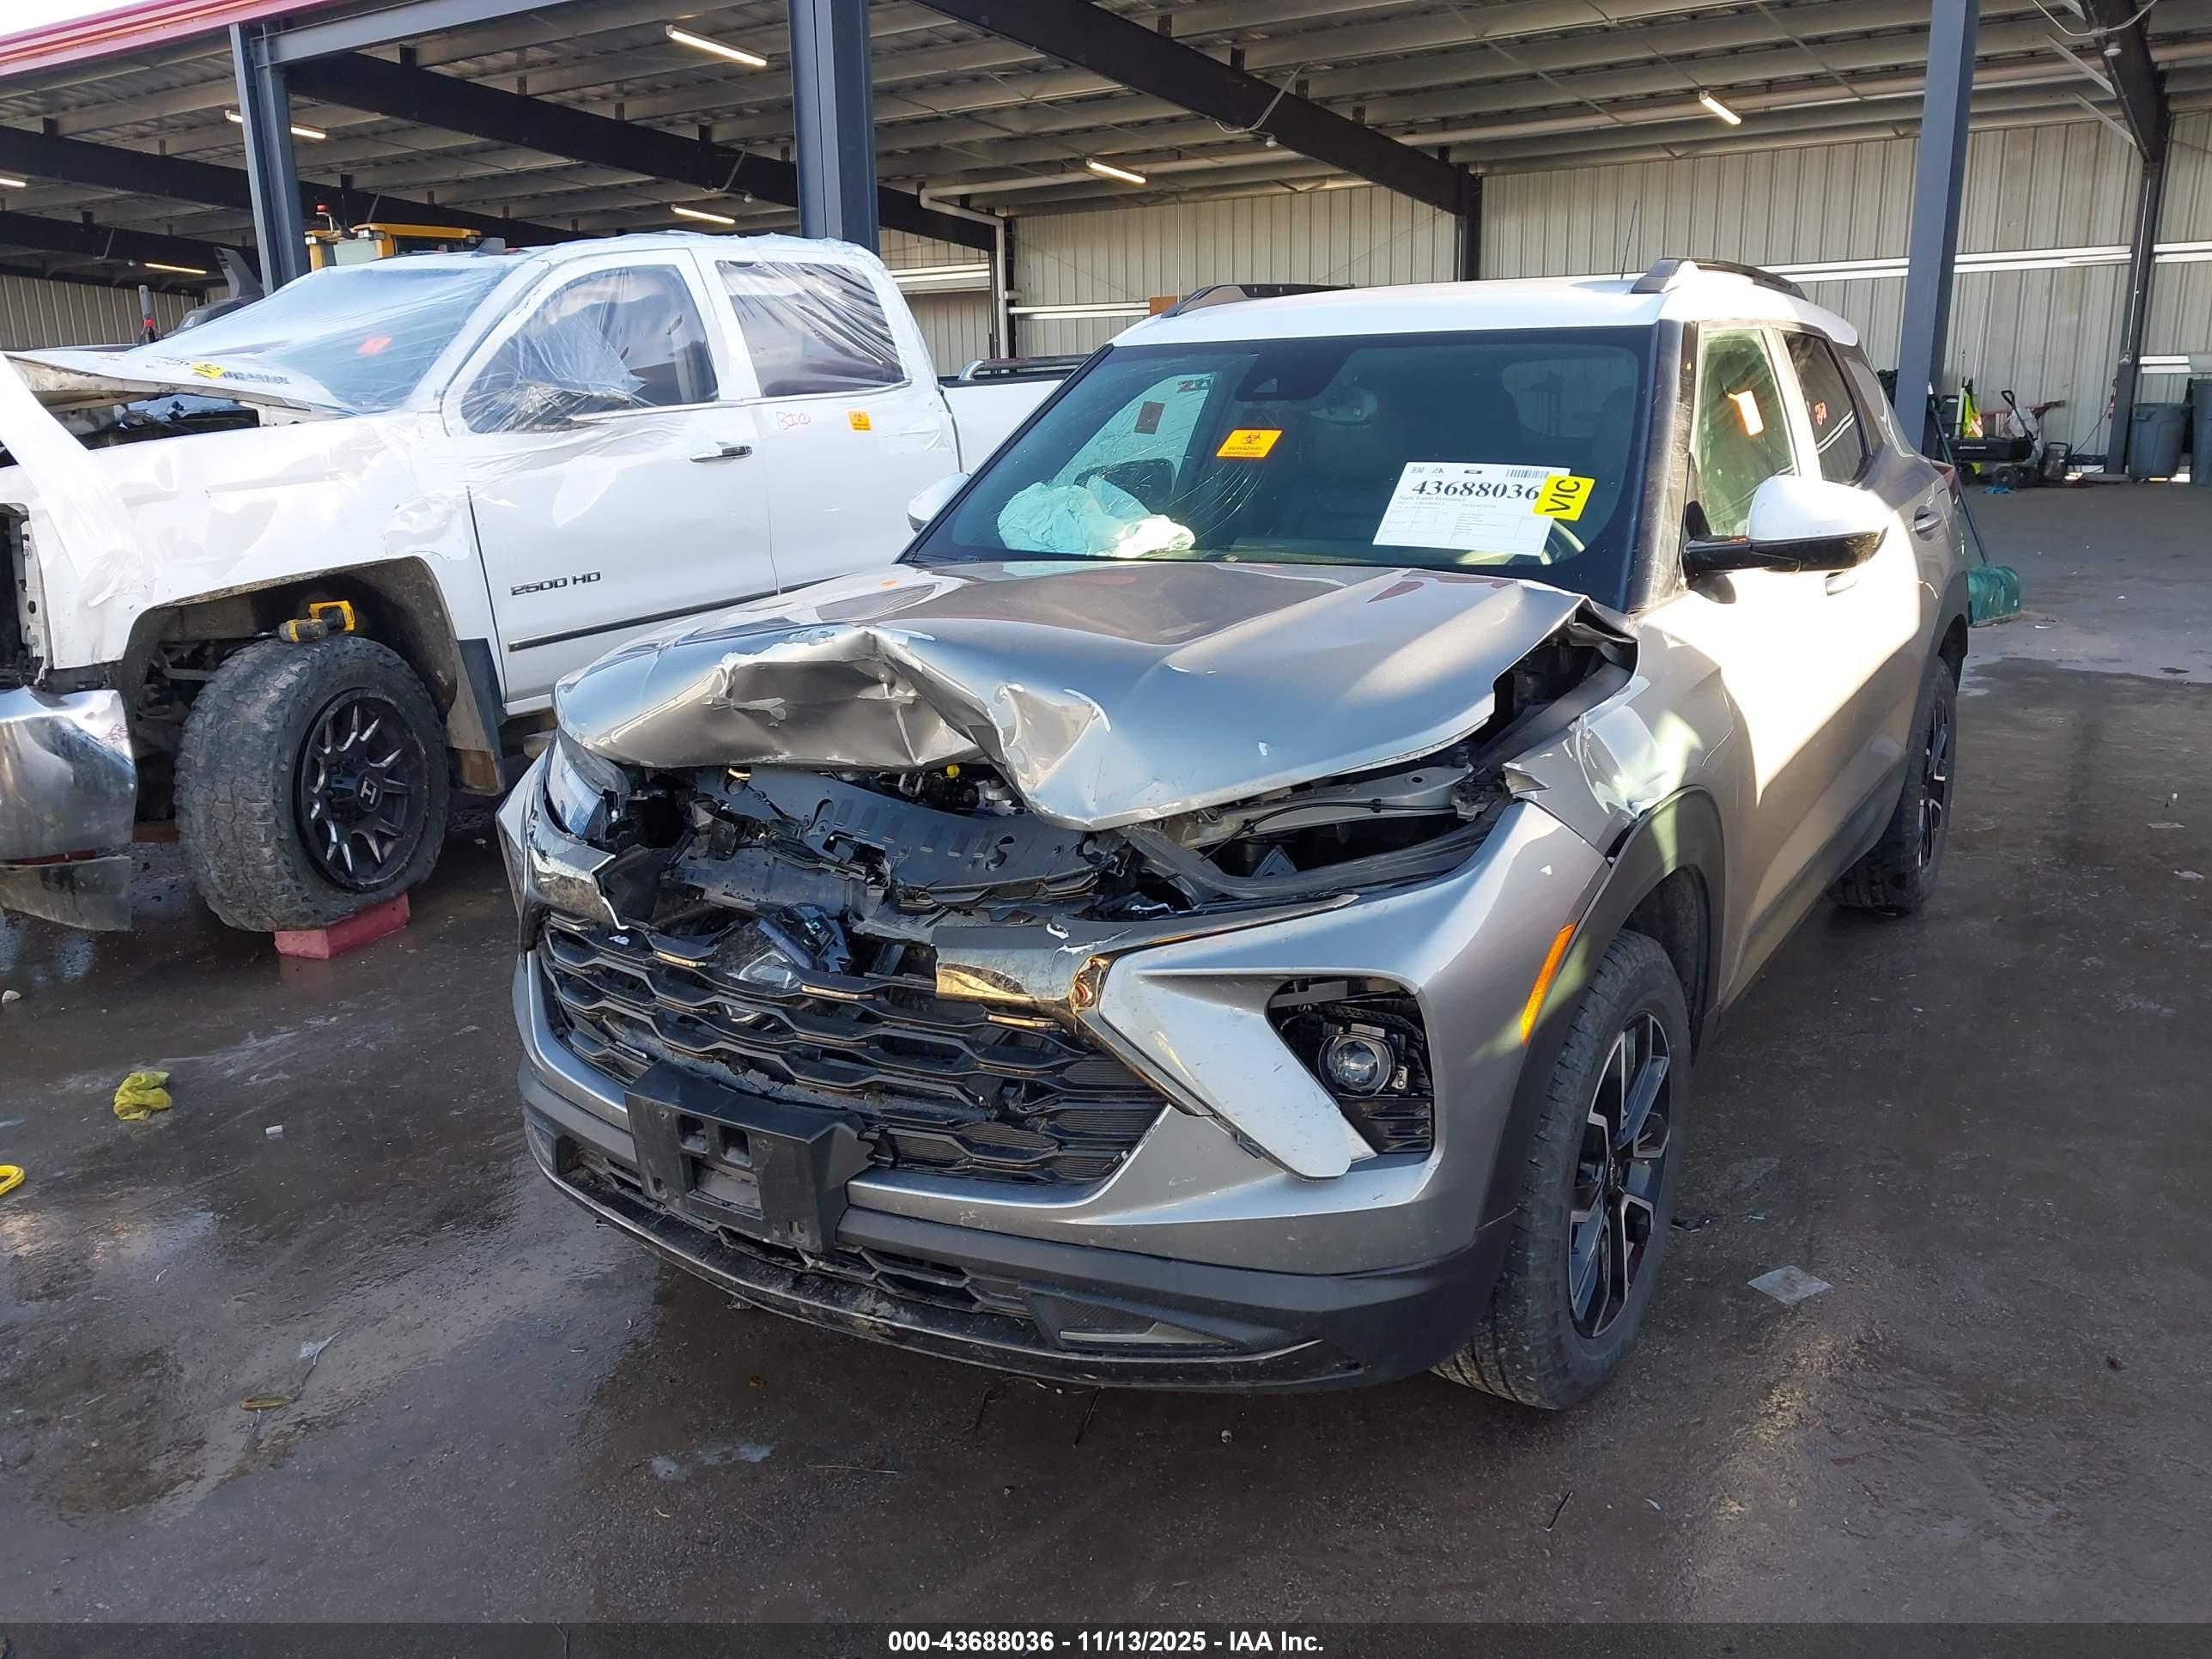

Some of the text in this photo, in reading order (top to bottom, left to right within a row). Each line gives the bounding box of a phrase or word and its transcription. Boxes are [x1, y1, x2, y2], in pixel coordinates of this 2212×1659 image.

[1412, 479, 1542, 501] 43688036
[1544, 478, 1581, 513] VIC
[510, 570, 601, 596] 2500 HD
